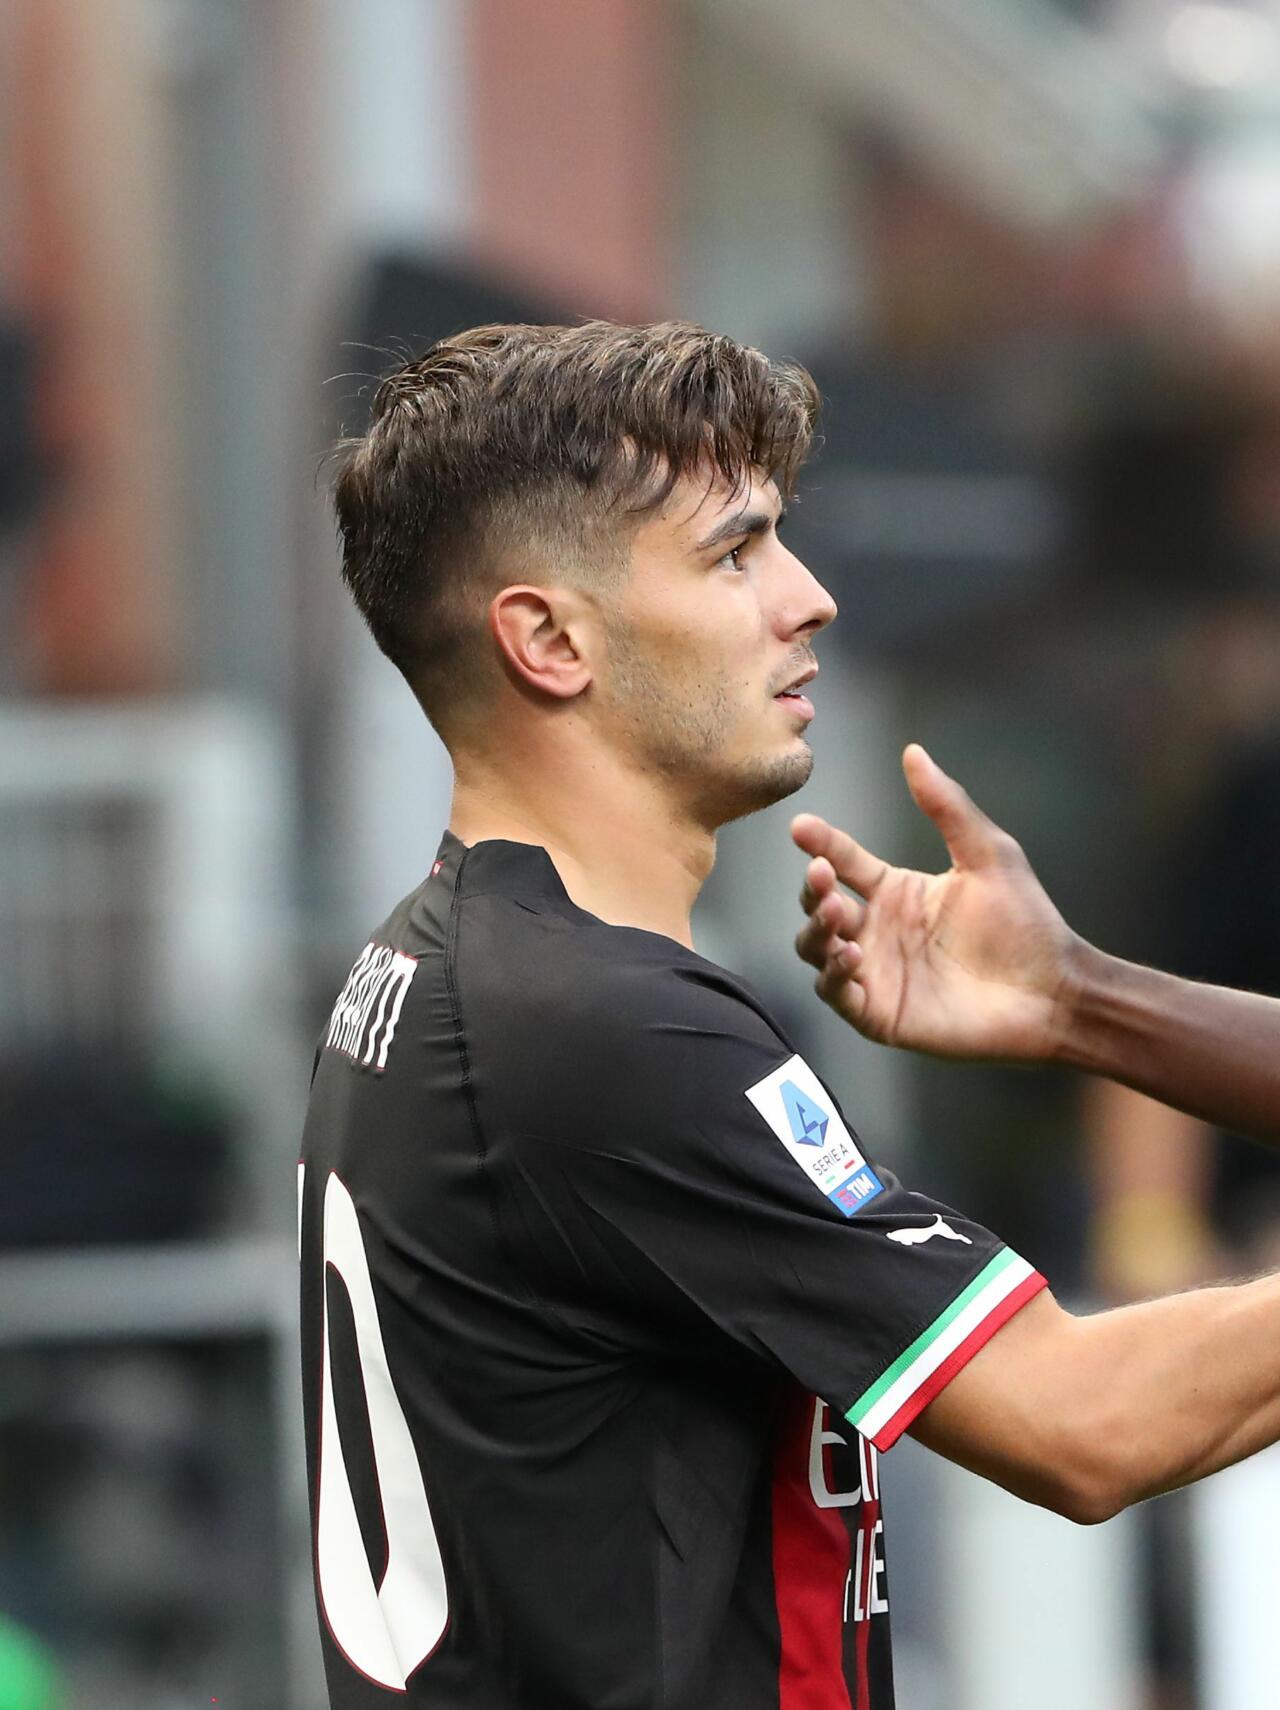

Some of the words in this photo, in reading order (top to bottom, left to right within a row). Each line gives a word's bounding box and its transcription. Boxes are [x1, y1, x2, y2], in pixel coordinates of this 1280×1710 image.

[812, 1148, 841, 1176] SERIE
[840, 1144, 849, 1155] A
[847, 1173, 875, 1200] TIM
